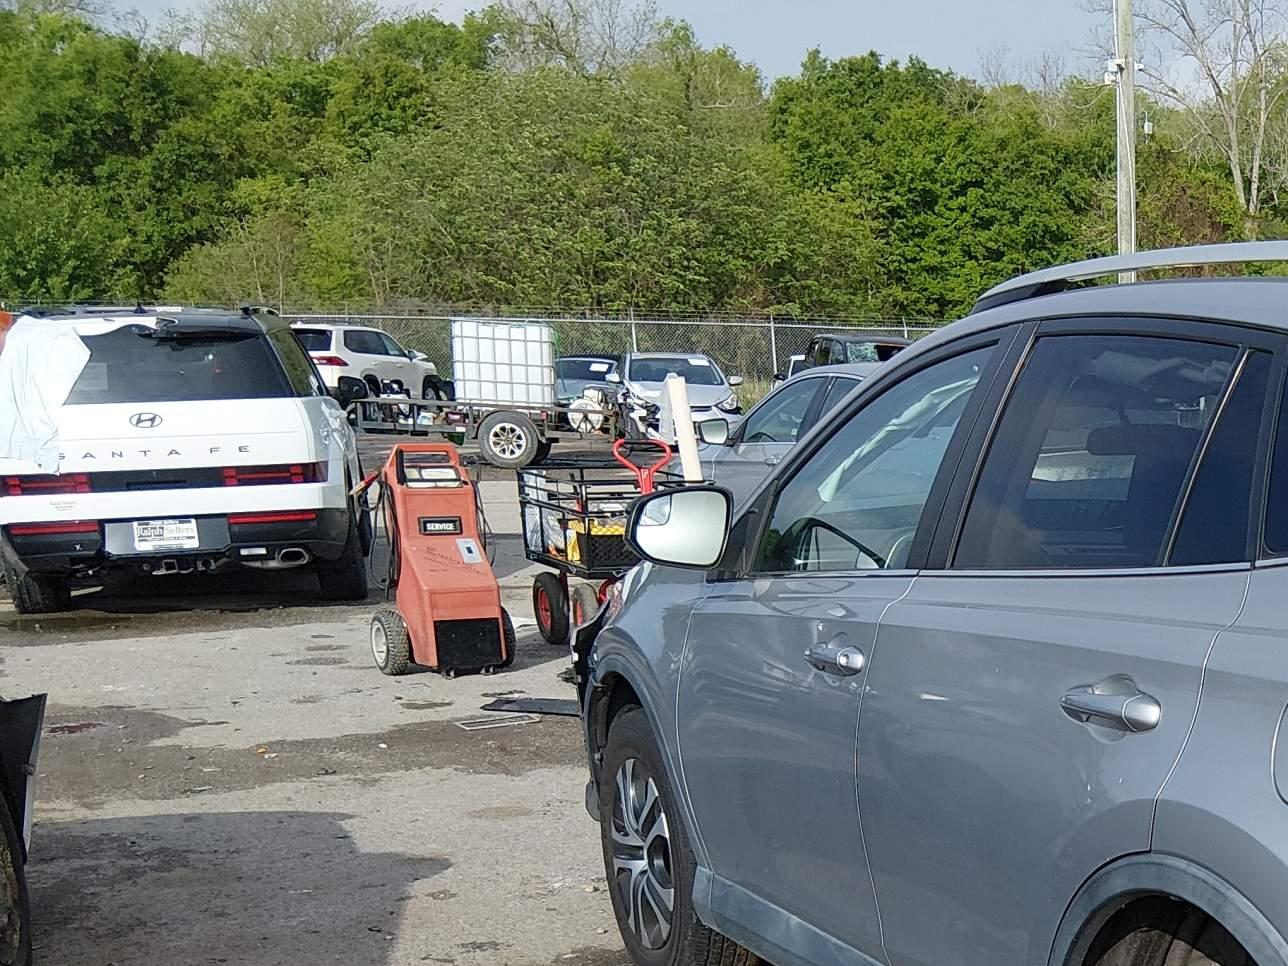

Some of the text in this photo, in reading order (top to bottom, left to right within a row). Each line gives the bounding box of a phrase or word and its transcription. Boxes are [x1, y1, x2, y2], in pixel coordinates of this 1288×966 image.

[58, 445, 250, 460] SANTA FE
[137, 526, 164, 539] Ralph
[426, 522, 456, 531] SERVICE
